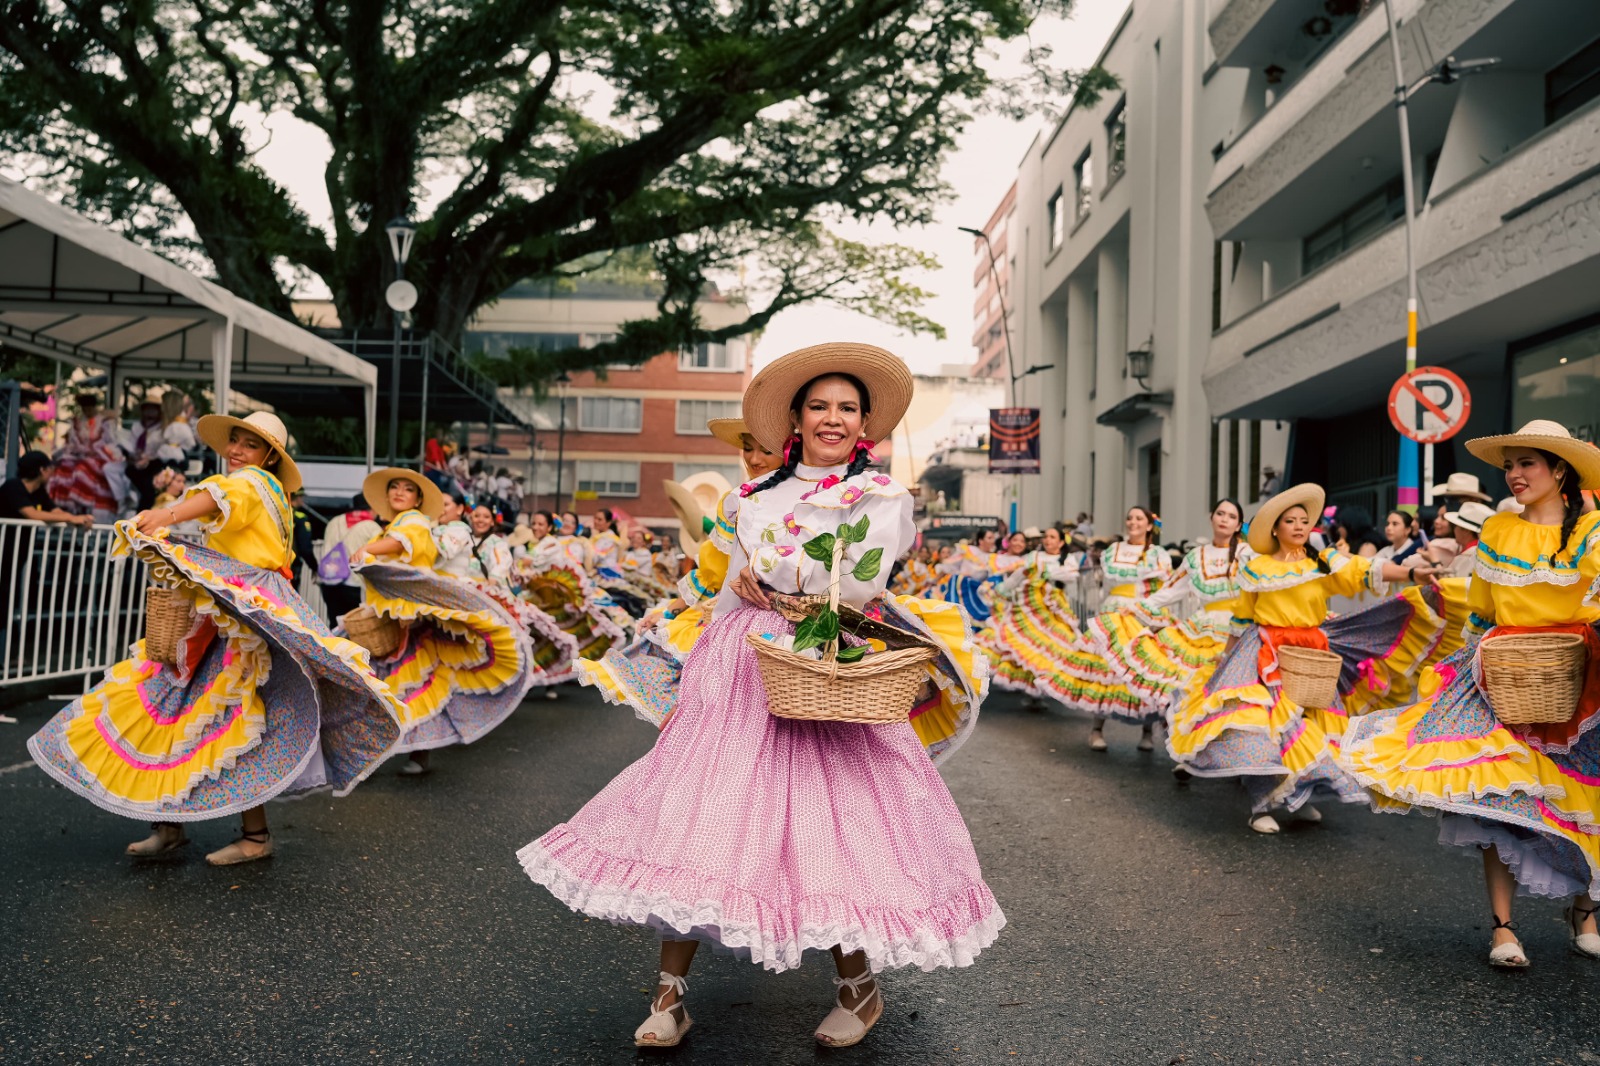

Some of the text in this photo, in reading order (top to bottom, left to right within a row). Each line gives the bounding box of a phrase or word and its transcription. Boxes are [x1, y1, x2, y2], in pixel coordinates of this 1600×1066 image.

[1415, 380, 1453, 430] P
[940, 517, 997, 527] LIQUOR PLAZA
